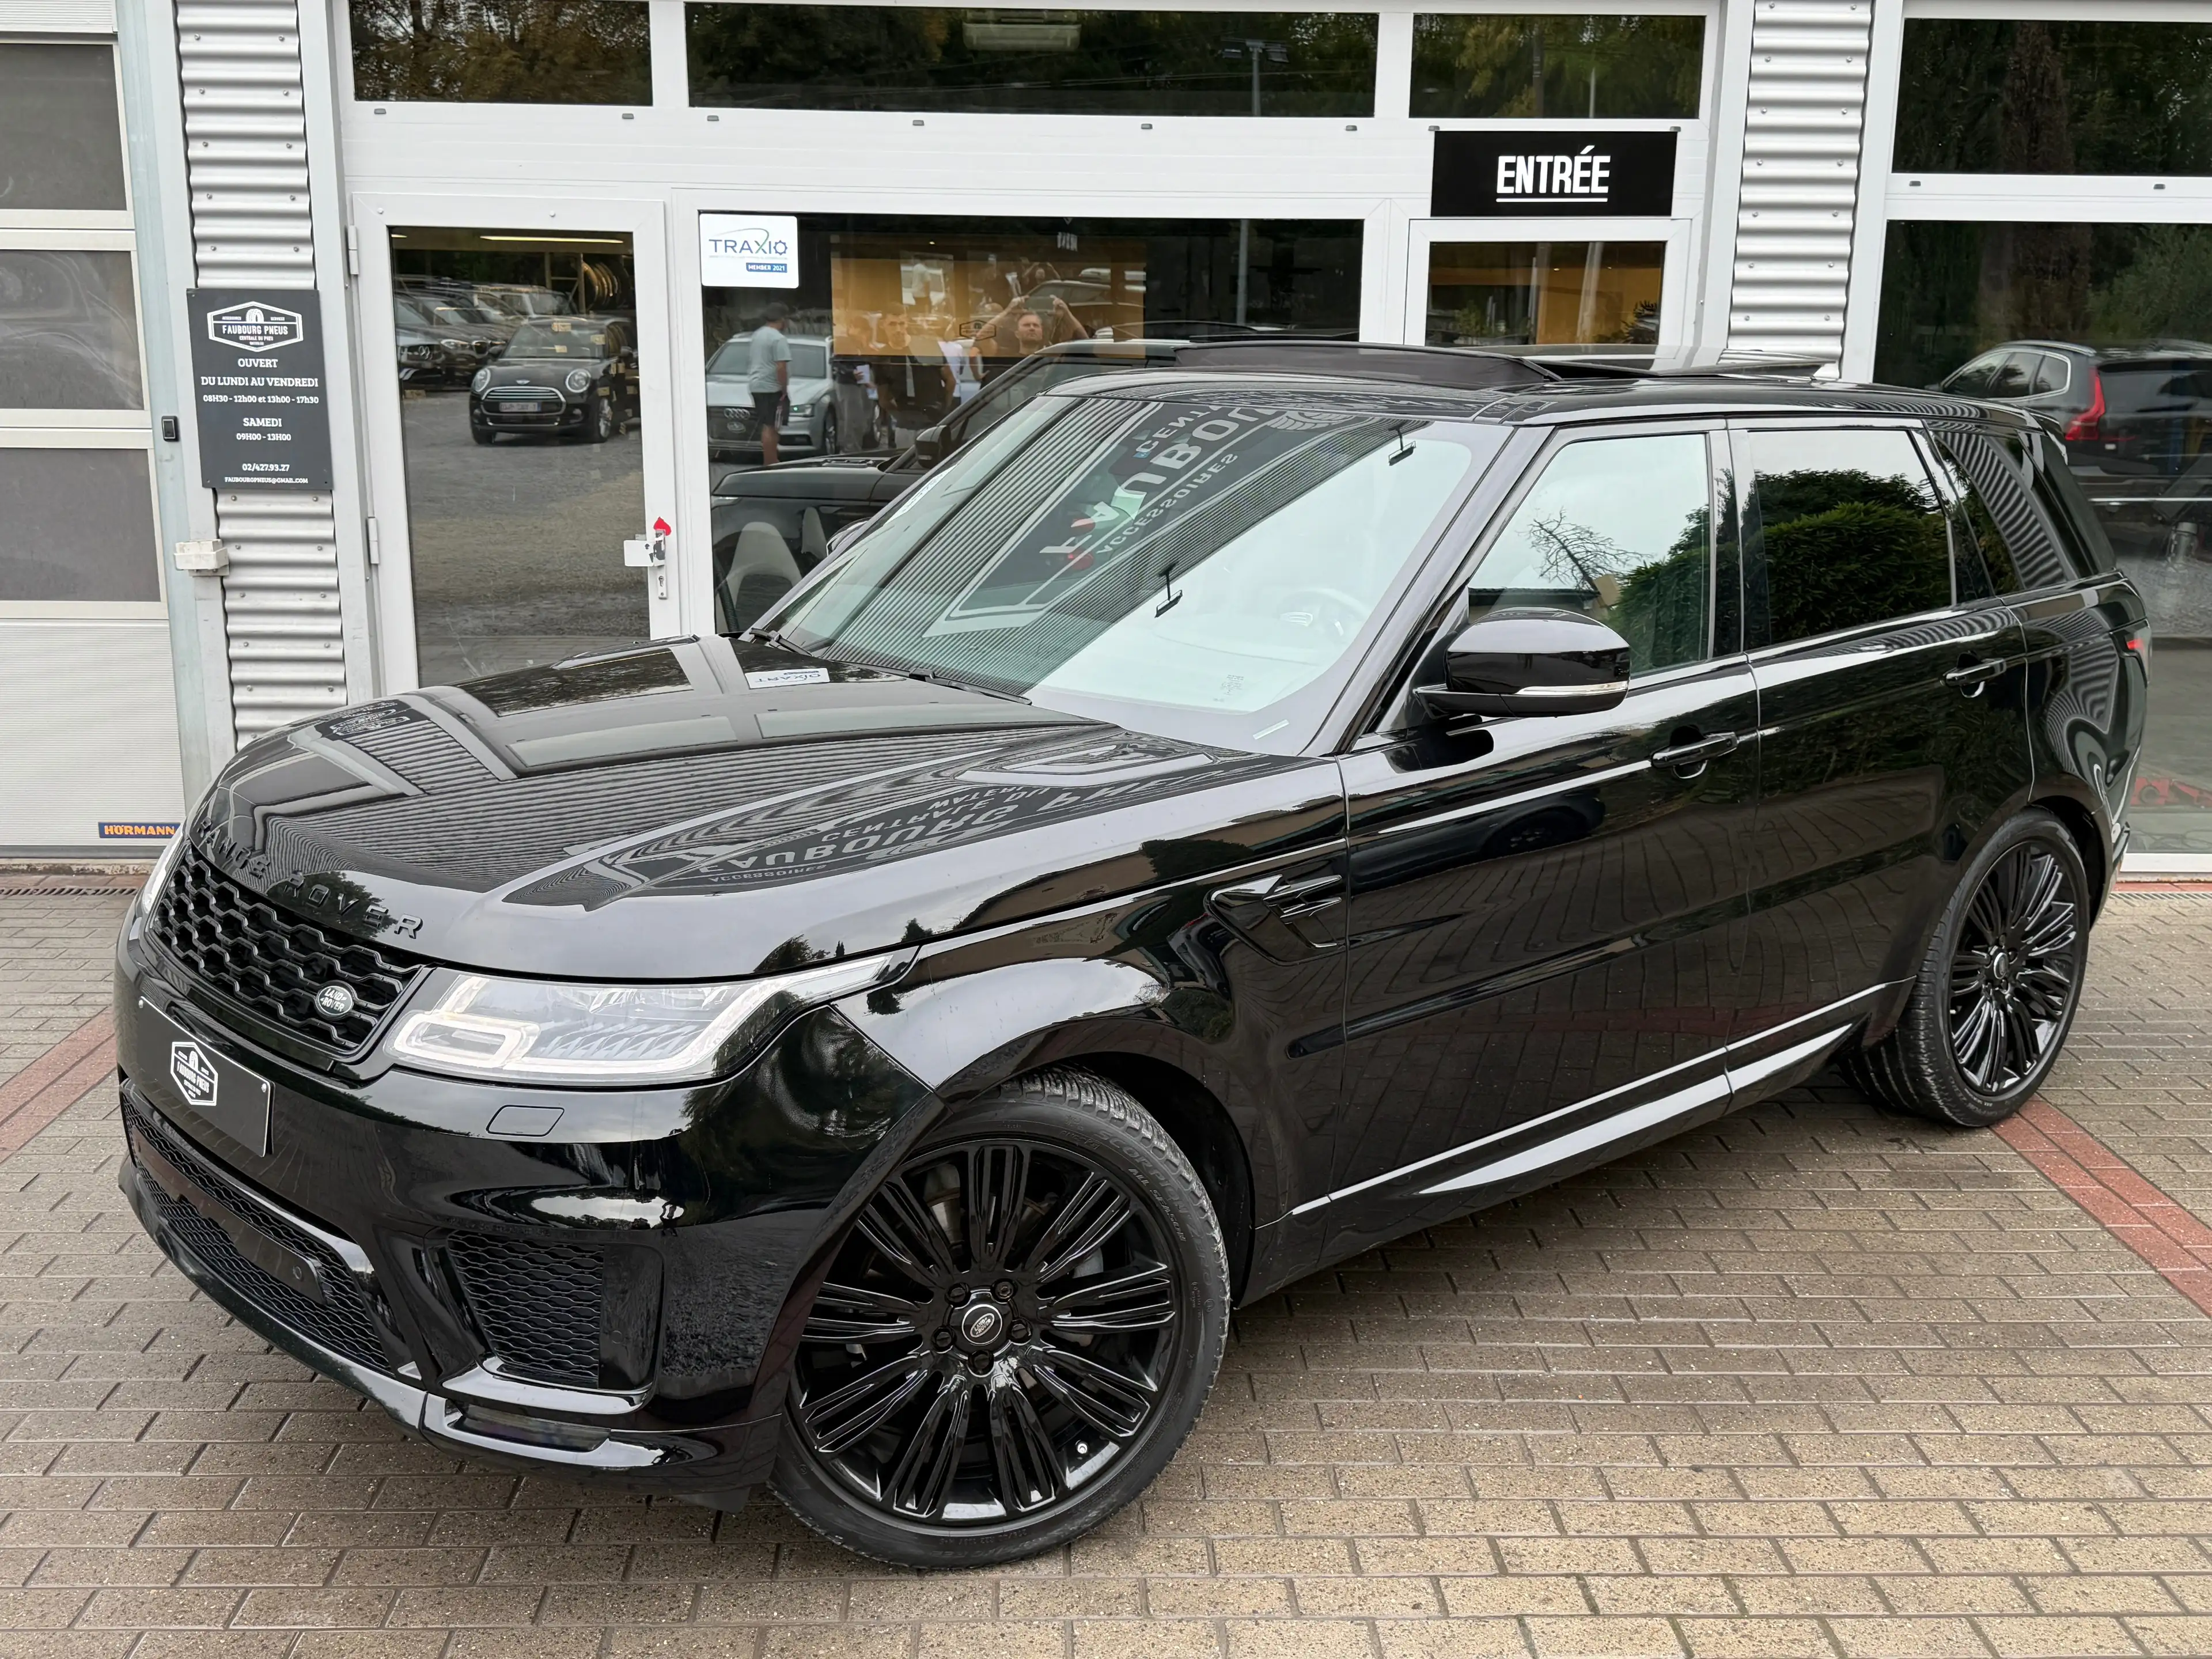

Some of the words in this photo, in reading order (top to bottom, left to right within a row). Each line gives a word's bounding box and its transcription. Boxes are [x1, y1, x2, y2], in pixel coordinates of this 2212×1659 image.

[1496, 145, 1611, 194] ENTRÉE
[709, 238, 788, 256] TRAXIO
[222, 324, 262, 335] FAUBOURG
[264, 325, 289, 335] PNEUS
[237, 358, 278, 368] OUVERT
[201, 377, 216, 386] DU
[217, 377, 249, 387] LUNDI
[250, 377, 265, 387] AU
[267, 377, 319, 388] VENDREDI
[203, 395, 228, 403] 08H30
[233, 395, 257, 403] 12h00
[267, 395, 290, 404] 13h00
[296, 395, 319, 404] 17h30
[243, 418, 282, 427] SAMEDI
[236, 433, 262, 441] 09H00
[267, 433, 291, 441] 13H00
[242, 463, 290, 472] 02/427.93.27
[104, 824, 176, 835] HÖRMANN
[284, 869, 424, 940] ROVER
[324, 988, 344, 1001] LAND
[321, 997, 345, 1012] ROVER
[1093, 1128, 1190, 1212] SCORPION
[1128, 1168, 1149, 1187] ALL
[1149, 1190, 1187, 1243] SEASON
[974, 1320, 986, 1331] LAND
[978, 1318, 992, 1334] ROVER
